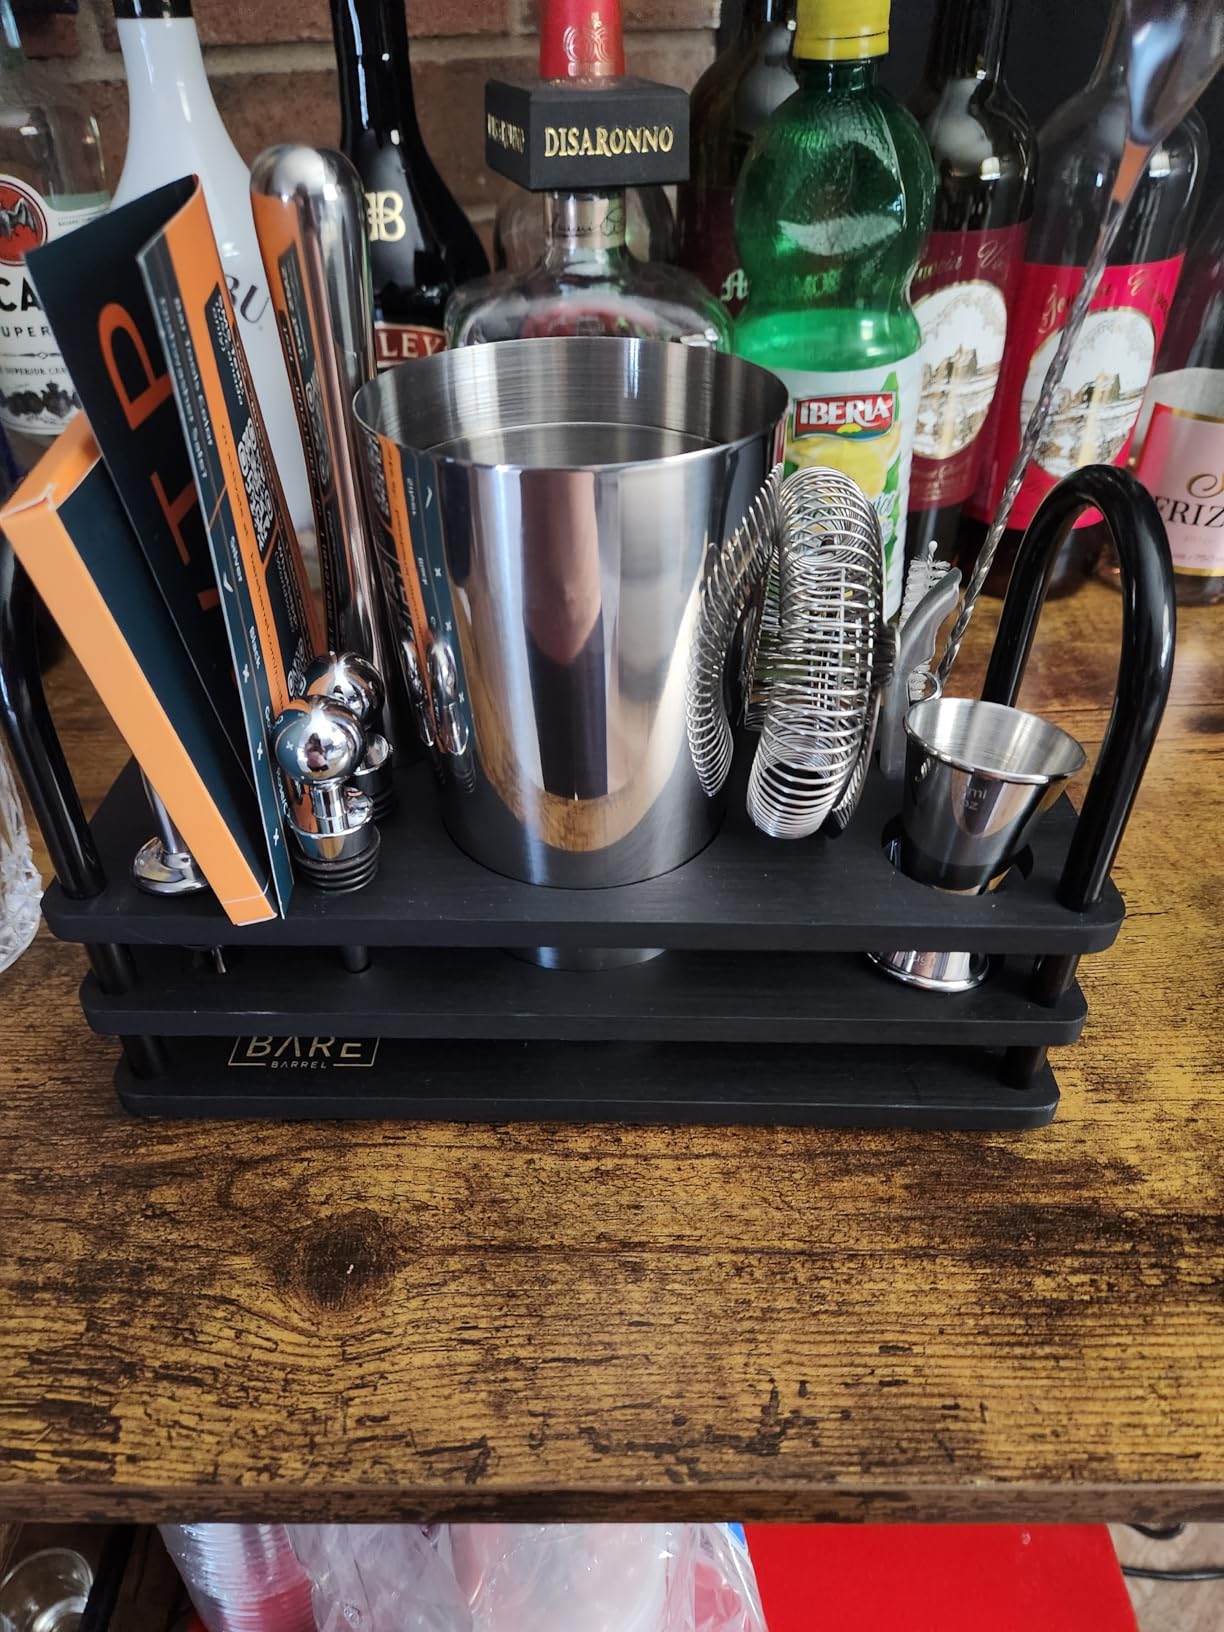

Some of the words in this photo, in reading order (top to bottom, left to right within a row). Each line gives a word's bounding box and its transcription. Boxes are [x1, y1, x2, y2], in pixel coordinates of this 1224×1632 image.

[543, 124, 675, 158] DISARONNO
[799, 396, 893, 428] IBERIA
[230, 535, 243, 583] Silver
[249, 625, 261, 670] Black
[246, 1036, 362, 1058] BARE
[271, 1061, 327, 1069] BARREL
